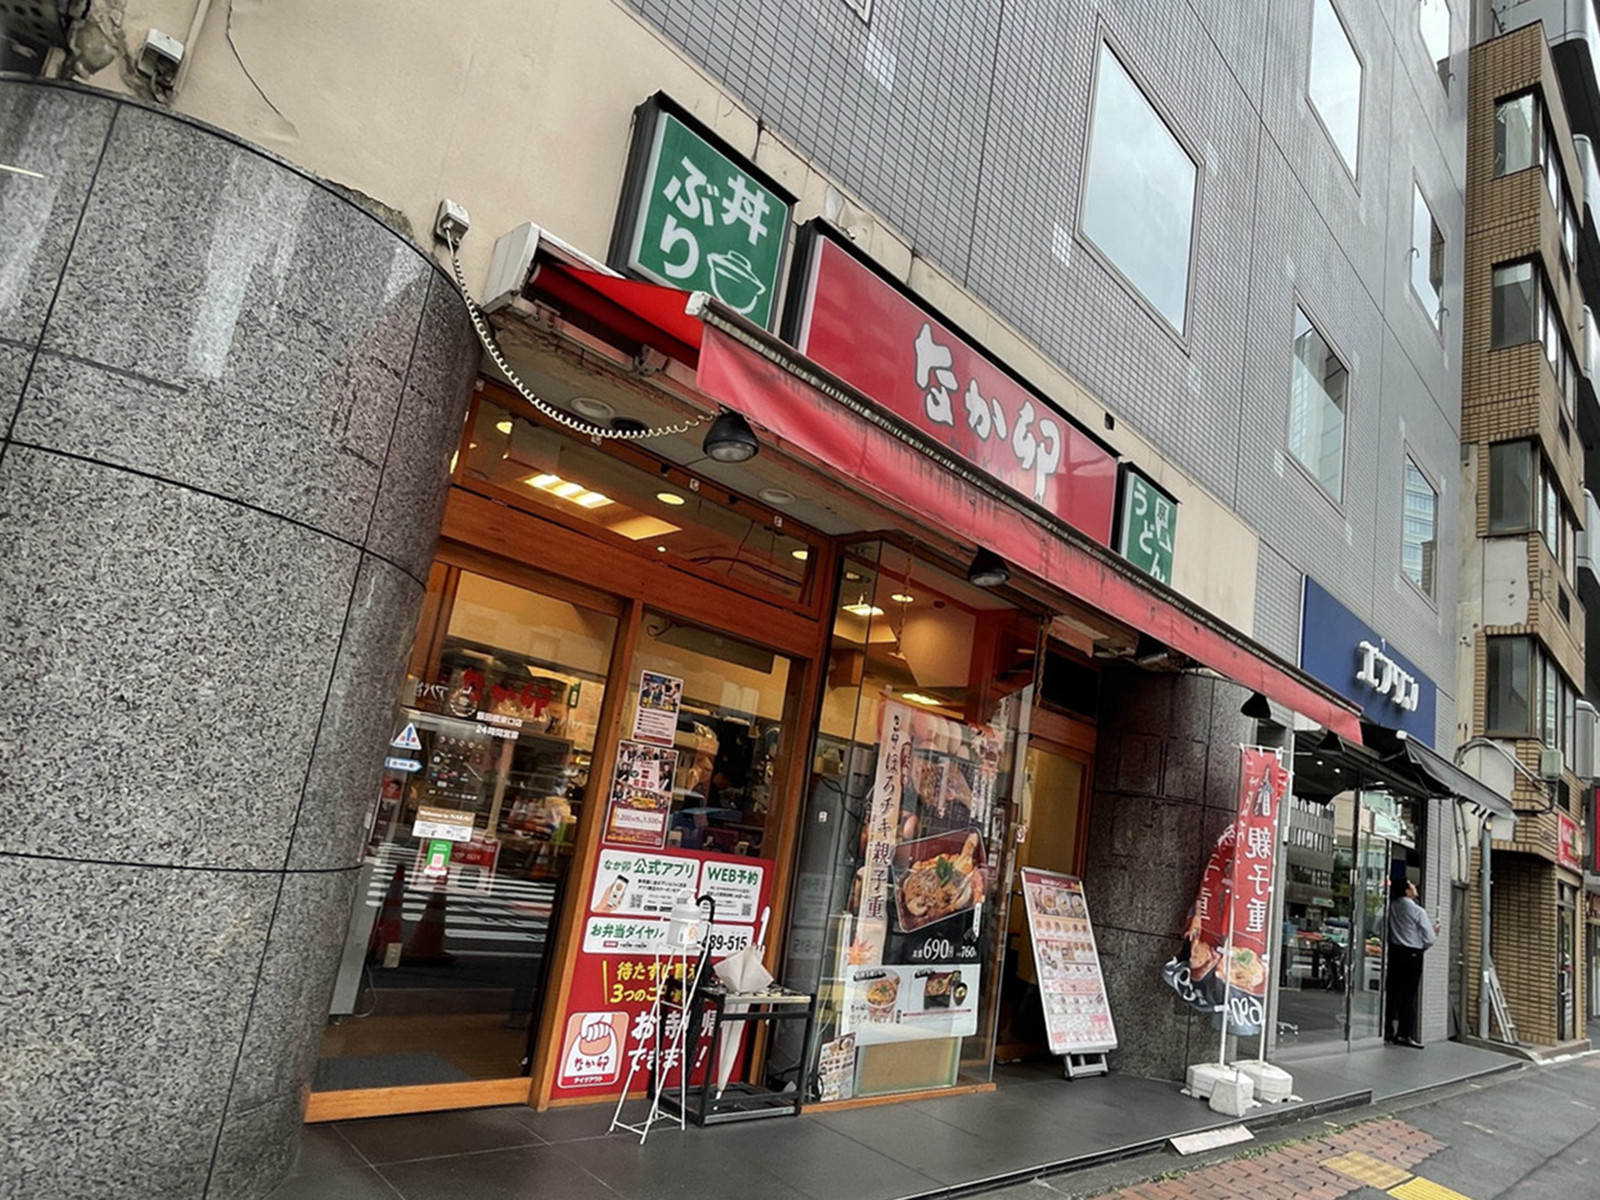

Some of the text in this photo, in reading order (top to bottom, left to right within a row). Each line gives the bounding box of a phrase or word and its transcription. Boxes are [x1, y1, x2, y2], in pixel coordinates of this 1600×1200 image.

[634, 858, 695, 879] 公式アプリ
[707, 866, 759, 886] WEB予約
